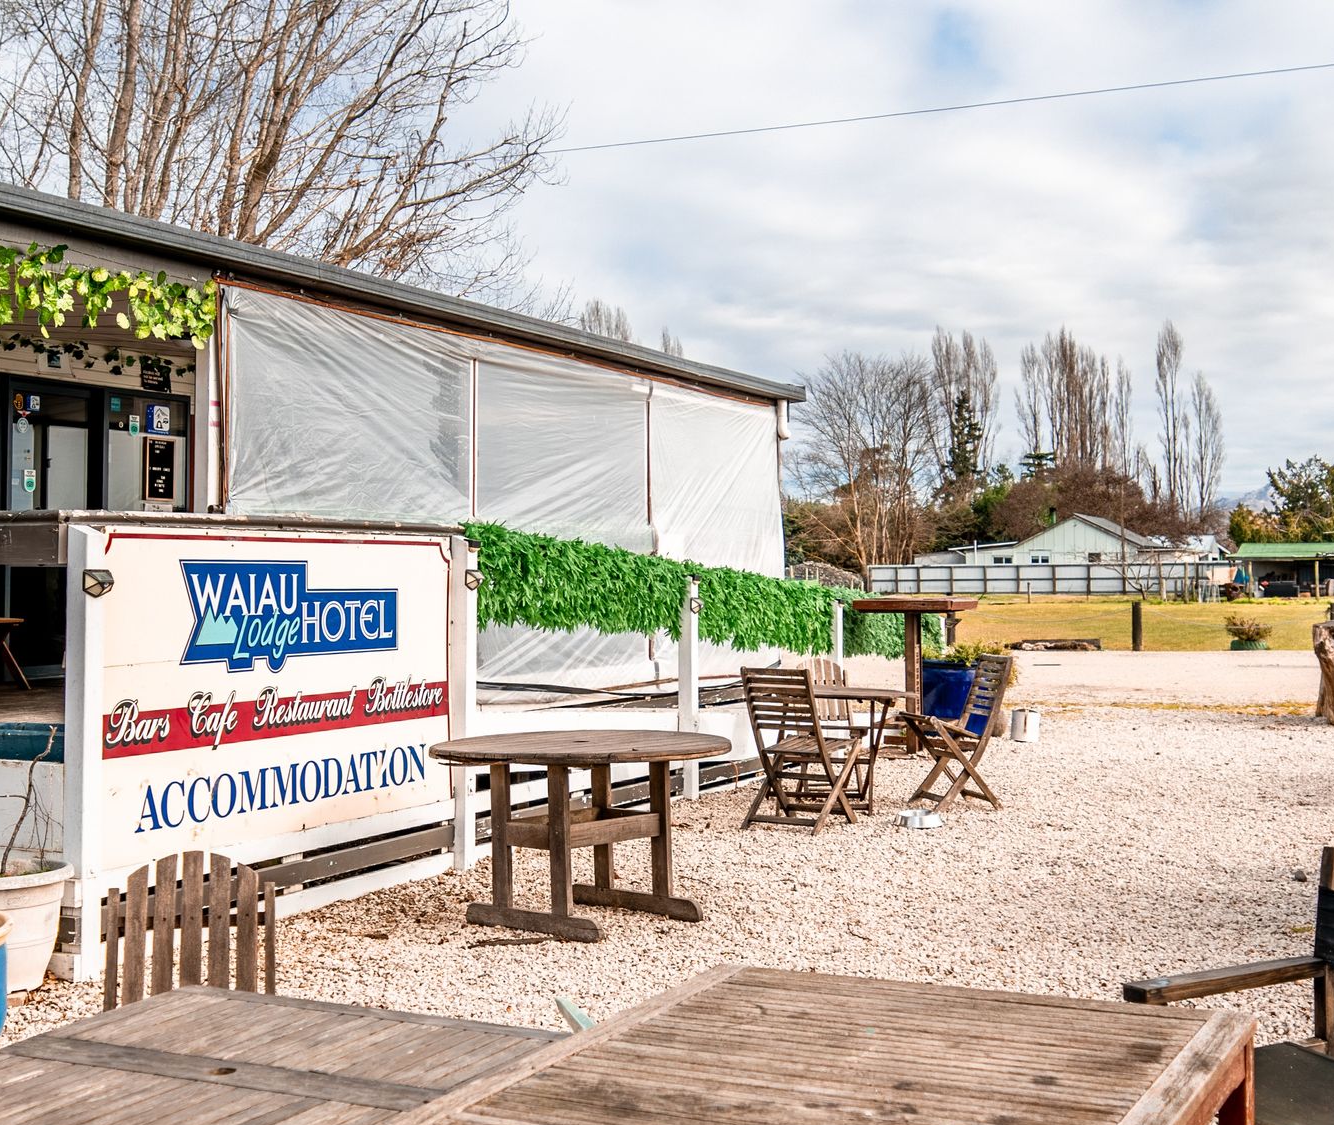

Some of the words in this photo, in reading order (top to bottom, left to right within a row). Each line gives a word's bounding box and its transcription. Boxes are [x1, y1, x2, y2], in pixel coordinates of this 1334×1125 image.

[190, 573, 299, 617] WAIAU
[301, 599, 393, 643] HOTEL
[232, 608, 300, 659] Lodge
[106, 699, 171, 744] Bars
[188, 690, 238, 749] Cafe
[252, 686, 357, 728] Restaurant
[365, 675, 443, 713] Bottlestore
[135, 743, 427, 833] ACCOMMODATION
